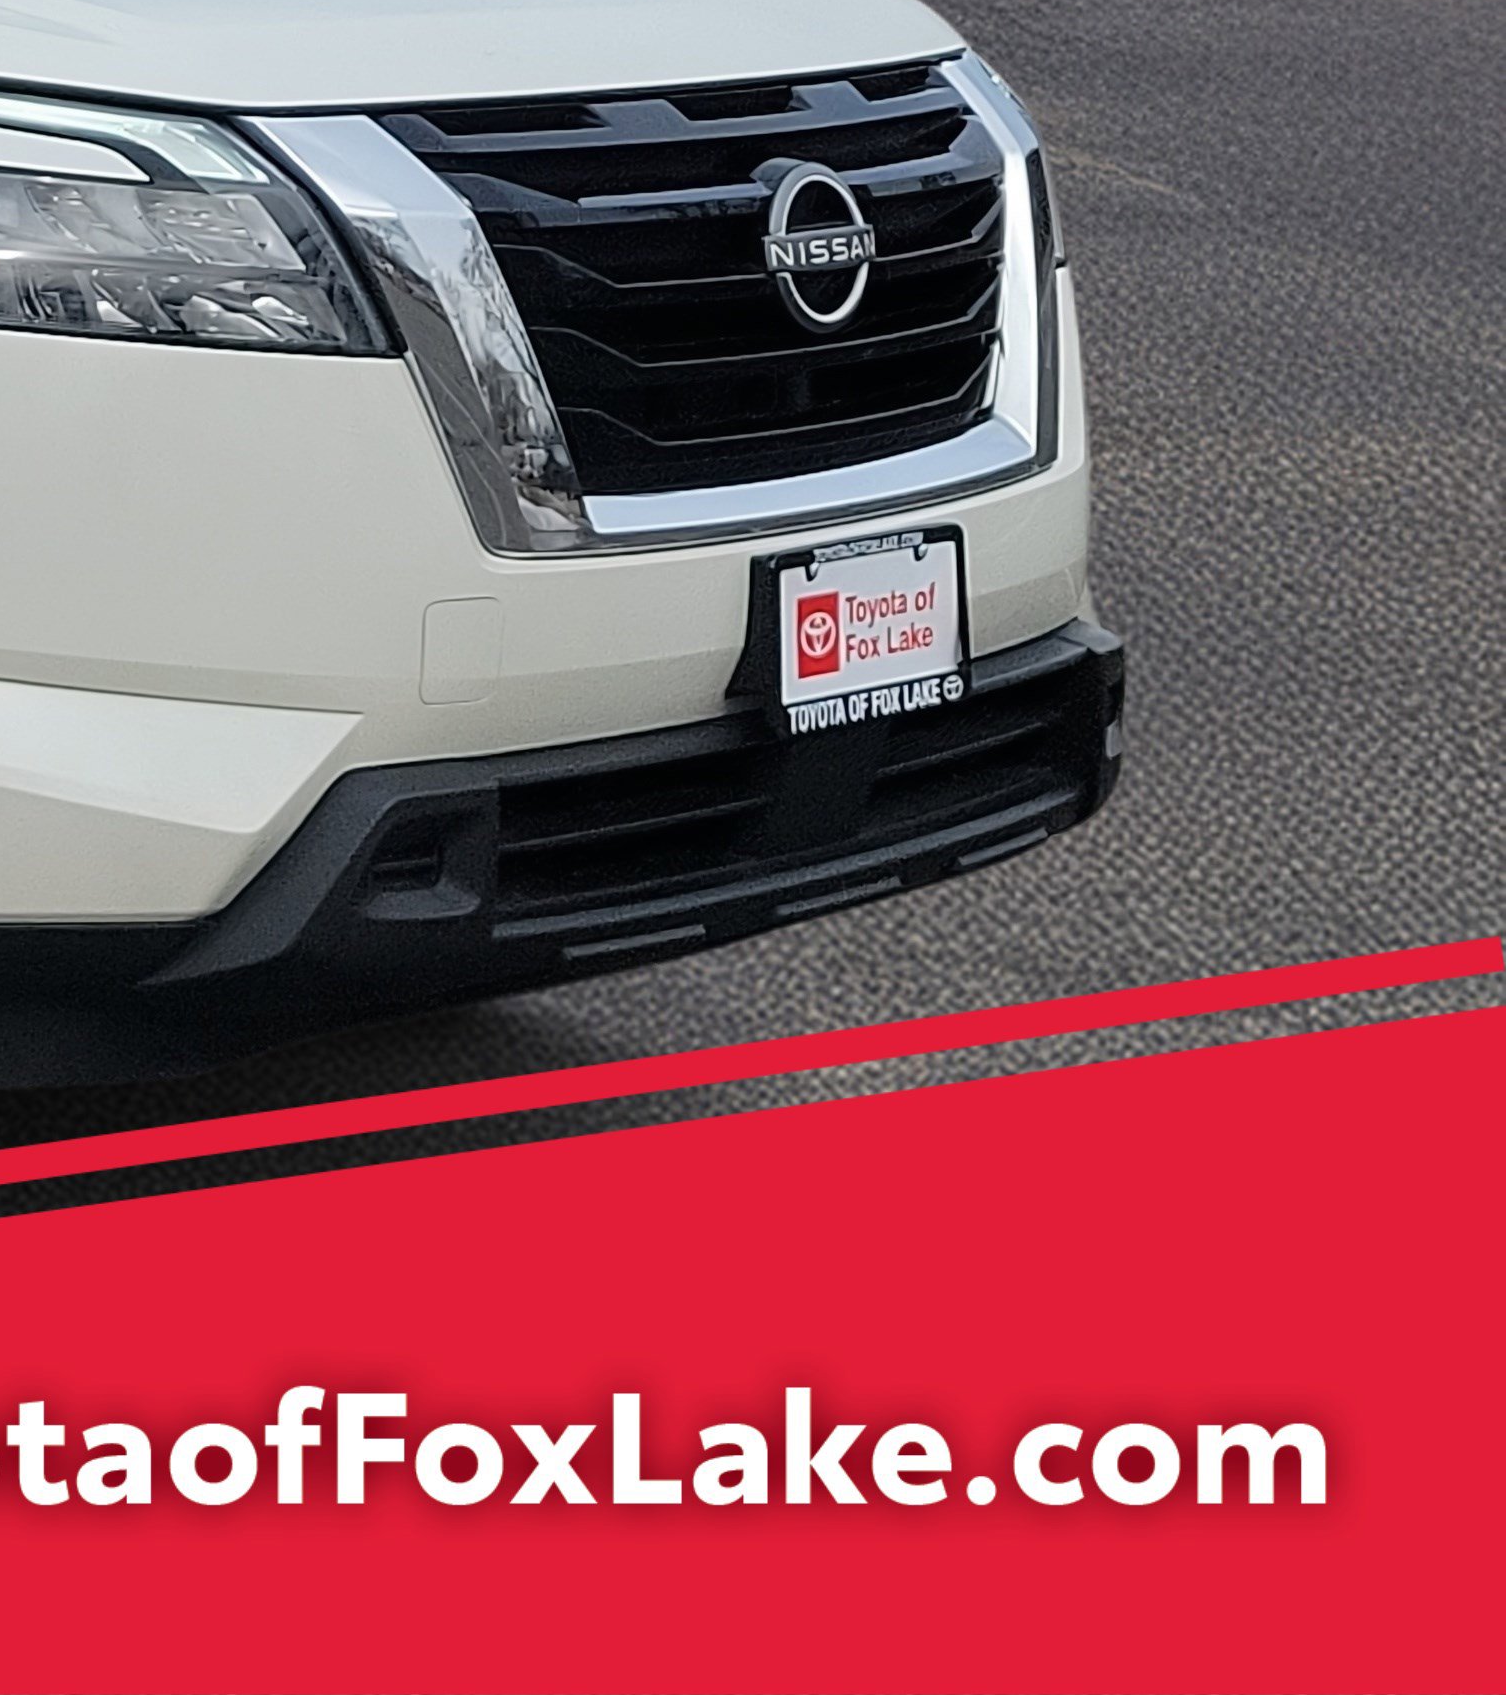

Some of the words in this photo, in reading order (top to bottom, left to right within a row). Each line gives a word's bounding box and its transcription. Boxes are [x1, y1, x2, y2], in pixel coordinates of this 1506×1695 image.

[770, 231, 876, 267] NISSAN
[845, 590, 908, 628] Toyota
[915, 581, 936, 610] of
[845, 634, 881, 663] Fox
[887, 622, 934, 654] Lake
[787, 695, 847, 735] TOYOTA
[848, 693, 869, 722] OF
[871, 687, 902, 718] FOX
[903, 678, 942, 712] LAKE
